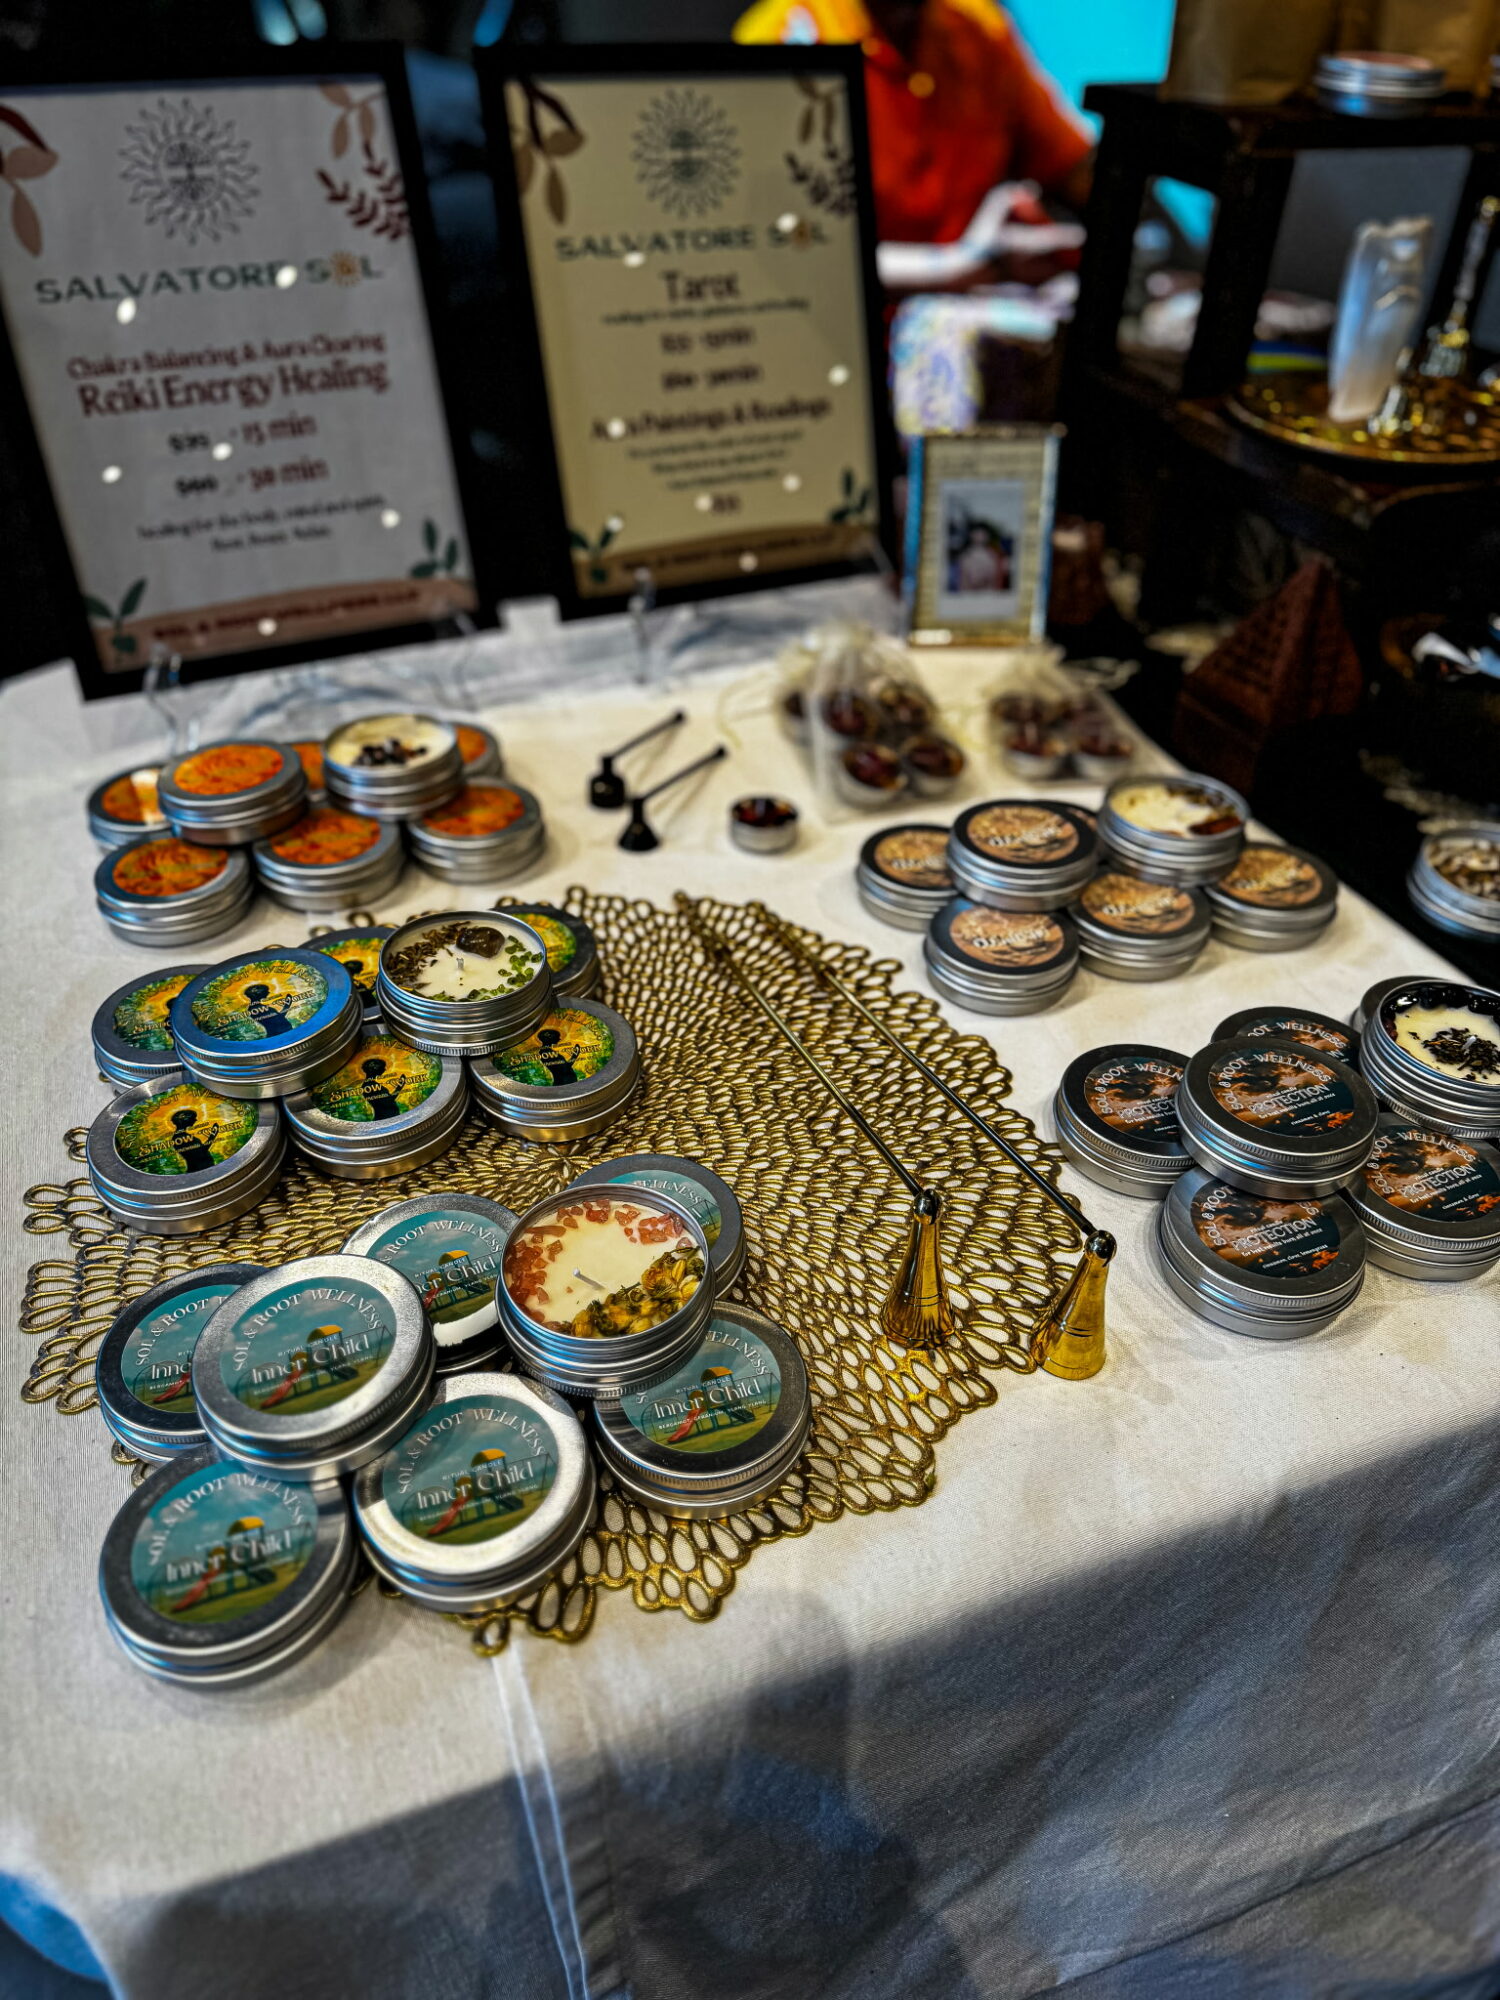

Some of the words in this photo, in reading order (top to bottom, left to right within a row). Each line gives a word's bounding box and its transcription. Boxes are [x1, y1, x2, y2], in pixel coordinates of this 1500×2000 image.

[35, 261, 291, 305] SALVATORE
[78, 375, 159, 418] Reiki
[162, 369, 272, 409] Energy
[280, 357, 390, 396] Healing
[1276, 1021, 1347, 1049] WELLNESS
[1097, 1064, 1130, 1086] ROOT
[1133, 1062, 1184, 1081] WELLN
[1219, 1056, 1250, 1080] ROOT
[1253, 1053, 1332, 1082] WELLNESS
[1095, 1094, 1114, 1114] SOL
[1117, 1099, 1176, 1119] PROTECT
[1222, 1090, 1244, 1110] SOL
[1247, 1083, 1330, 1114] PROTECTION
[1371, 1171, 1395, 1195] SOL
[1397, 1130, 1477, 1163] WELLNESS
[1398, 1163, 1477, 1198] PROTECTION
[1202, 1185, 1234, 1212] ROOT
[387, 1225, 426, 1254] ROOT
[433, 1220, 503, 1253] WELLNESS
[1204, 1223, 1228, 1246] SOL
[1231, 1216, 1318, 1252] PROTECTION
[415, 1277, 442, 1294] ner
[447, 1256, 496, 1282] Child
[136, 1339, 155, 1366] SOL
[151, 1326, 165, 1337] &
[162, 1298, 209, 1326] ROOT
[232, 1340, 251, 1372] SOL
[243, 1328, 257, 1339] &
[253, 1293, 302, 1327] ROOT
[308, 1288, 382, 1330] WELLNESS
[151, 1362, 192, 1380] Inne
[252, 1358, 307, 1385] Inner
[313, 1334, 370, 1364] Child
[653, 1395, 705, 1419] Inner
[709, 1379, 762, 1404] Child
[398, 1462, 415, 1494] SOL
[407, 1447, 422, 1460] &
[416, 1411, 464, 1446] ROOT
[472, 1408, 546, 1457] WELLNESS
[173, 1477, 228, 1513] ROOT
[417, 1482, 473, 1510] Inner
[478, 1461, 535, 1491] Child
[231, 1529, 292, 1564] Child
